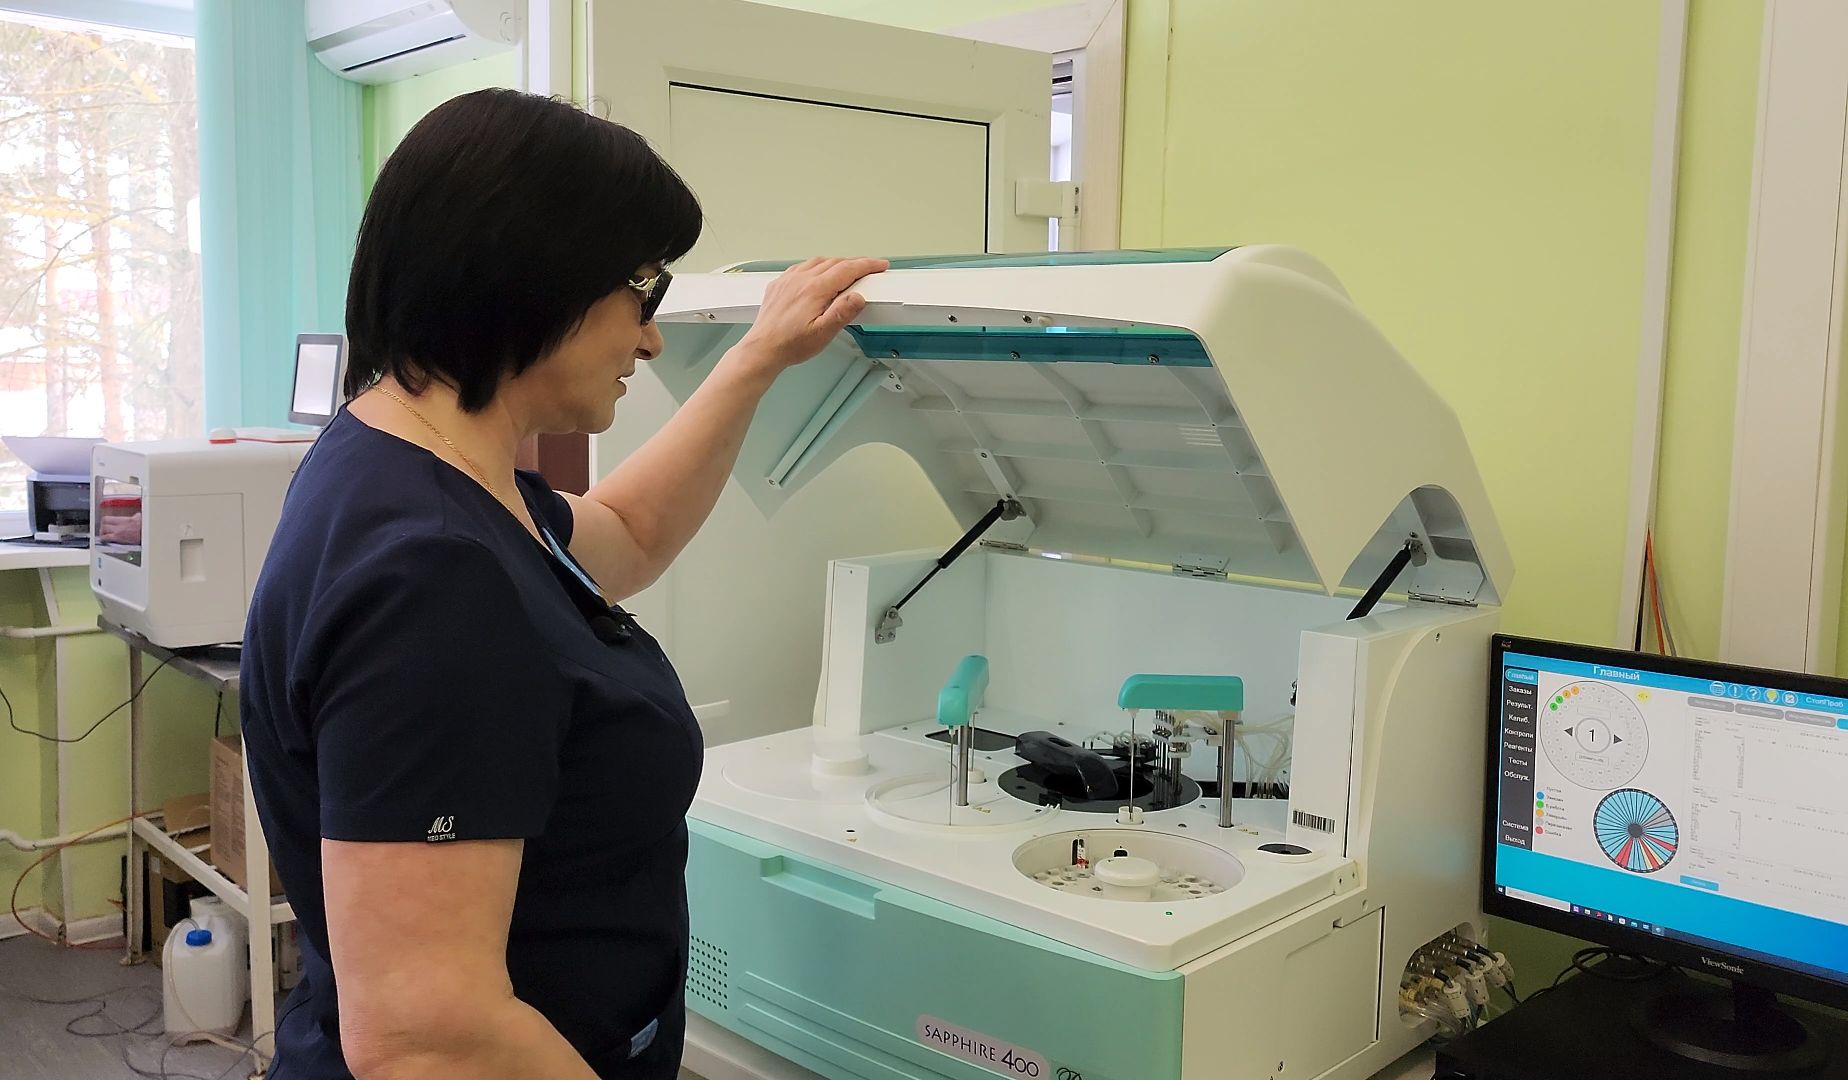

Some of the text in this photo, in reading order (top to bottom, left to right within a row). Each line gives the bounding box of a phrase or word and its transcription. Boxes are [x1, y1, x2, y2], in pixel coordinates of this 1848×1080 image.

[1593, 665, 1640, 681] Главный
[1508, 686, 1532, 695] Заказы
[1506, 699, 1534, 710] Результ.
[1508, 714, 1530, 724] Калиб.
[1504, 727, 1534, 739] Контроли
[1589, 728, 1595, 743] 1
[1503, 741, 1533, 753] Реагенты
[1508, 756, 1528, 767] Тесты
[1504, 770, 1531, 781] Обслуж.
[427, 815, 455, 834] MS
[1502, 819, 1529, 832] Система
[1505, 834, 1526, 846] Выход
[1701, 956, 1745, 975] ViewSonic
[925, 1024, 1039, 1078] SAPPHIRE 400
